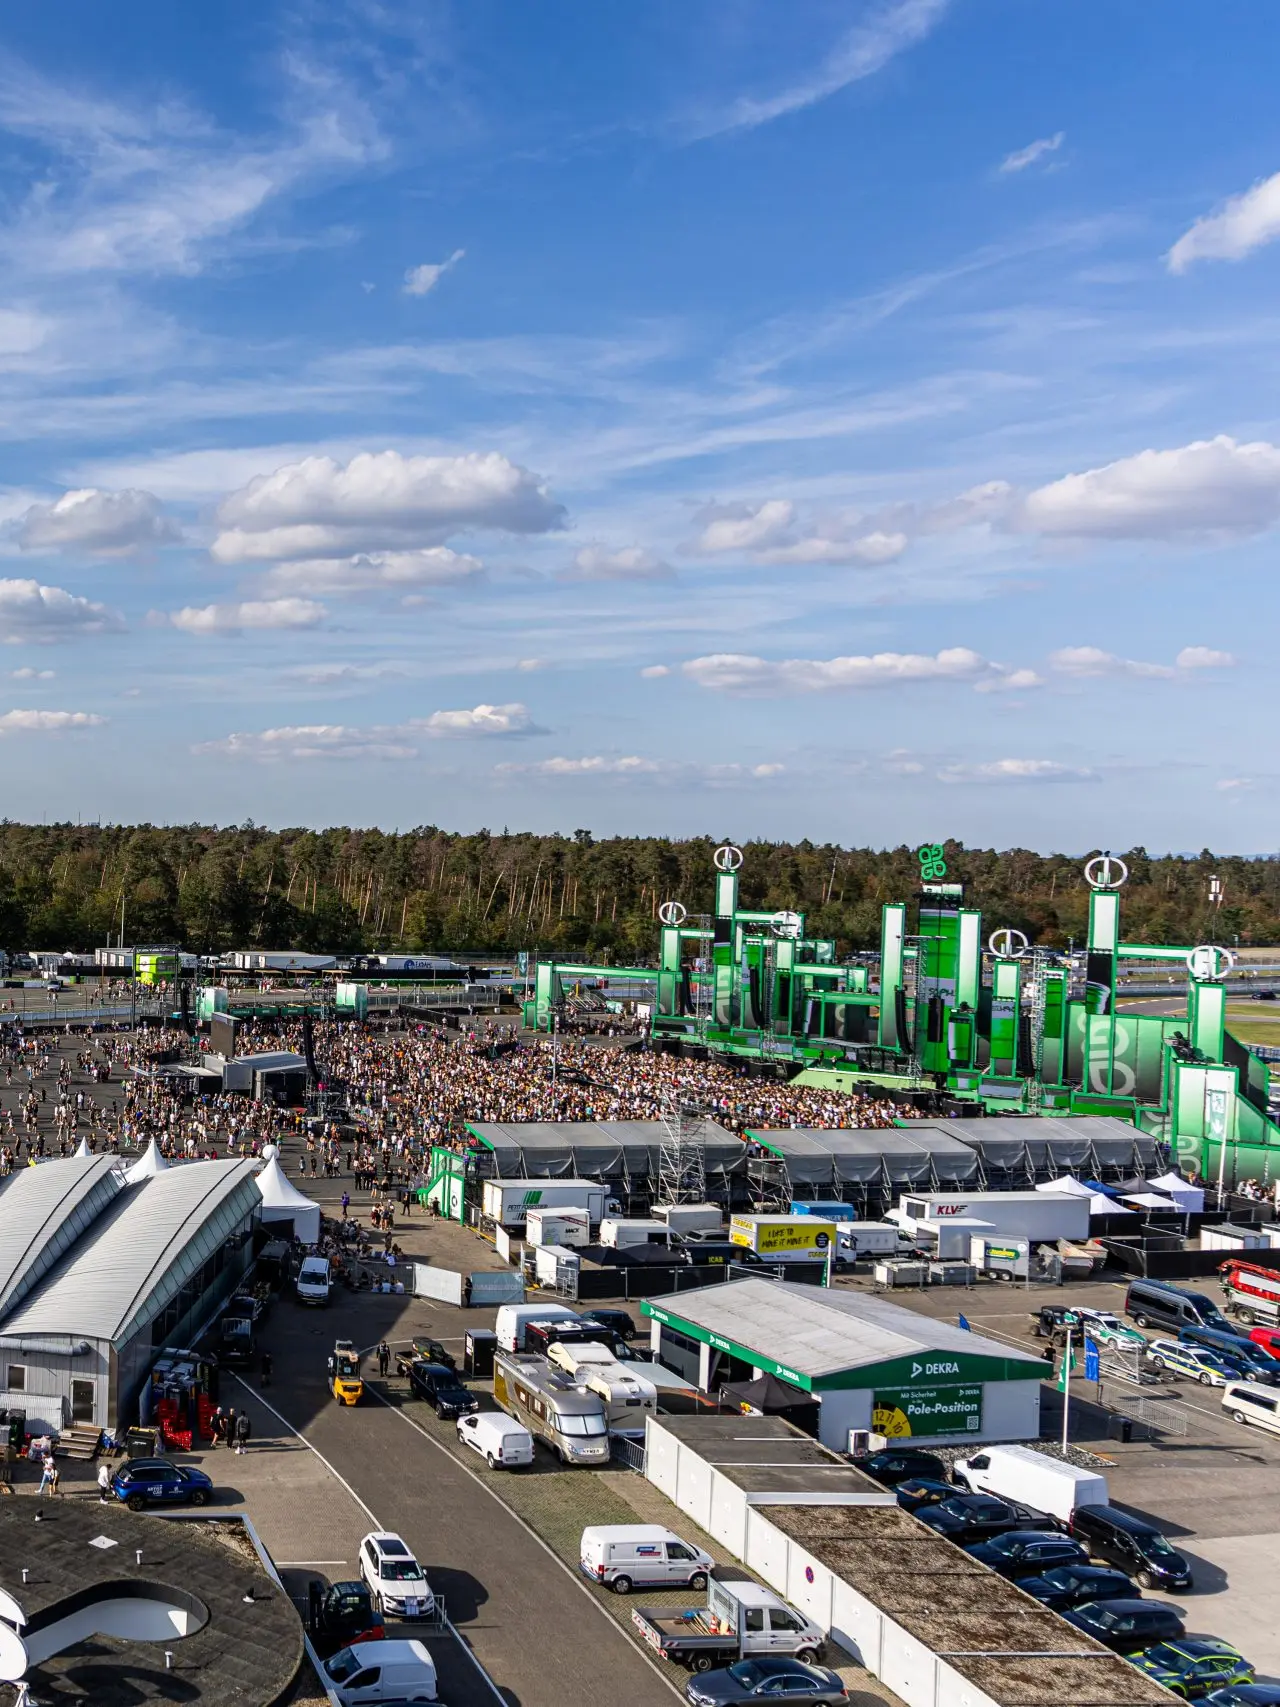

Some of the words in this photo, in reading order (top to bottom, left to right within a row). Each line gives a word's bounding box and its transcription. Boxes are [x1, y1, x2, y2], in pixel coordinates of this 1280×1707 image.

[937, 1205, 958, 1215] KLV
[926, 1362, 959, 1374] DEKRA
[907, 1401, 978, 1415] Pole-Position
[875, 1410, 884, 1422] 12
